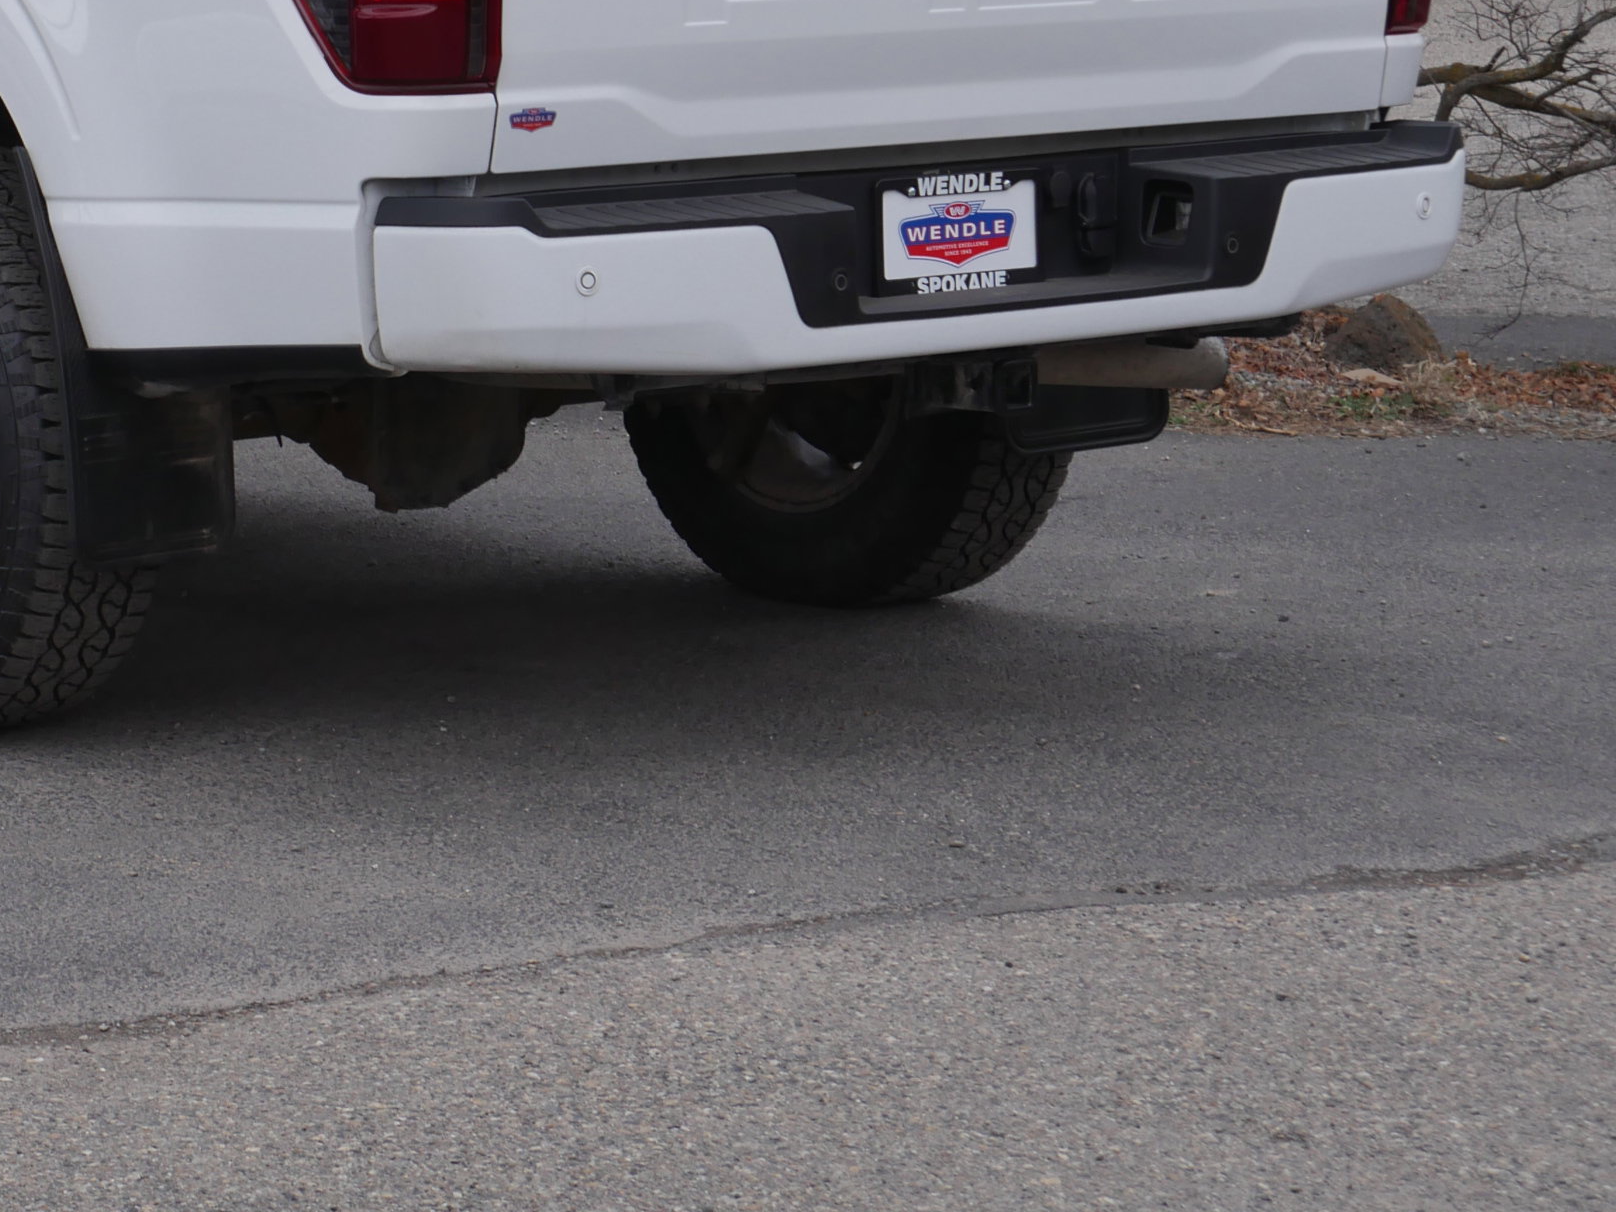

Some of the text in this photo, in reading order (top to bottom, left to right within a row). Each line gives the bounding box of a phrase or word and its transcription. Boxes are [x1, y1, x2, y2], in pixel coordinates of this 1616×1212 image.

[513, 115, 553, 123] WENDLE
[917, 171, 1004, 197] WENDLE
[907, 219, 1006, 242] WENDLE
[917, 270, 1008, 295] SPOKANE
